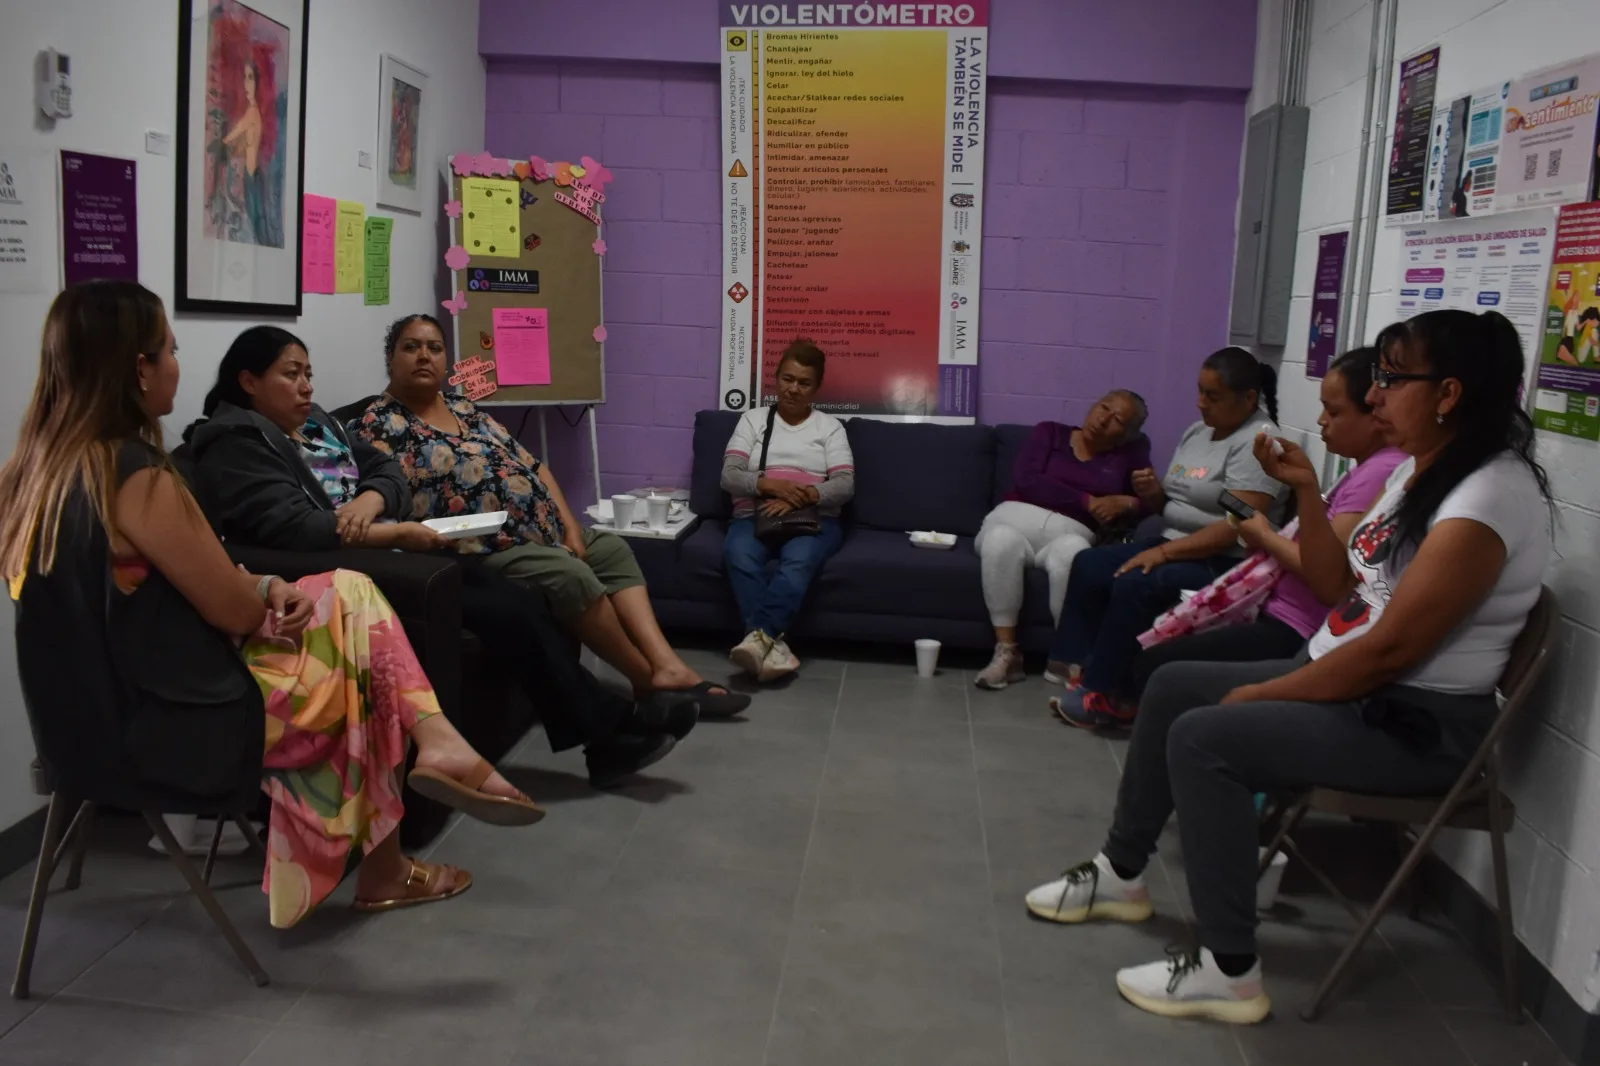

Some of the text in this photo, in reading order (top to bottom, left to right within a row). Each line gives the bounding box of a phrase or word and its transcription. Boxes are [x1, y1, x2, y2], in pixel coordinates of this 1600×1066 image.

[730, 0, 975, 25] VIOLENTÓMETRO
[800, 32, 839, 40] Hirientes
[766, 45, 812, 54] Chantajear
[730, 56, 736, 65] LA
[798, 57, 832, 66] engañar
[801, 70, 815, 78] ley
[968, 37, 982, 148] LA VIOLENCIA
[766, 93, 841, 102] Acechar/Stalkear
[952, 37, 967, 173] TAMBIÉN SE MIDE
[766, 106, 818, 114] Culpabilizar
[817, 142, 849, 151] público
[842, 166, 888, 175] personales
[810, 178, 844, 186] prohibir
[730, 183, 737, 194] NO
[575, 193, 593, 206] TUS
[592, 191, 605, 202] DE
[731, 197, 738, 207] TE
[556, 193, 601, 225] DERECHOS
[802, 216, 842, 224] agresivas
[767, 227, 800, 235] Golpear
[804, 251, 839, 259] jalonear
[500, 271, 528, 282] IMM
[825, 309, 856, 317] objetos
[801, 320, 842, 328] contenido
[879, 328, 916, 337] digitales
[956, 320, 968, 350] IMM
[455, 359, 475, 370] TIPOS
[450, 362, 494, 384] MODALIDADES
